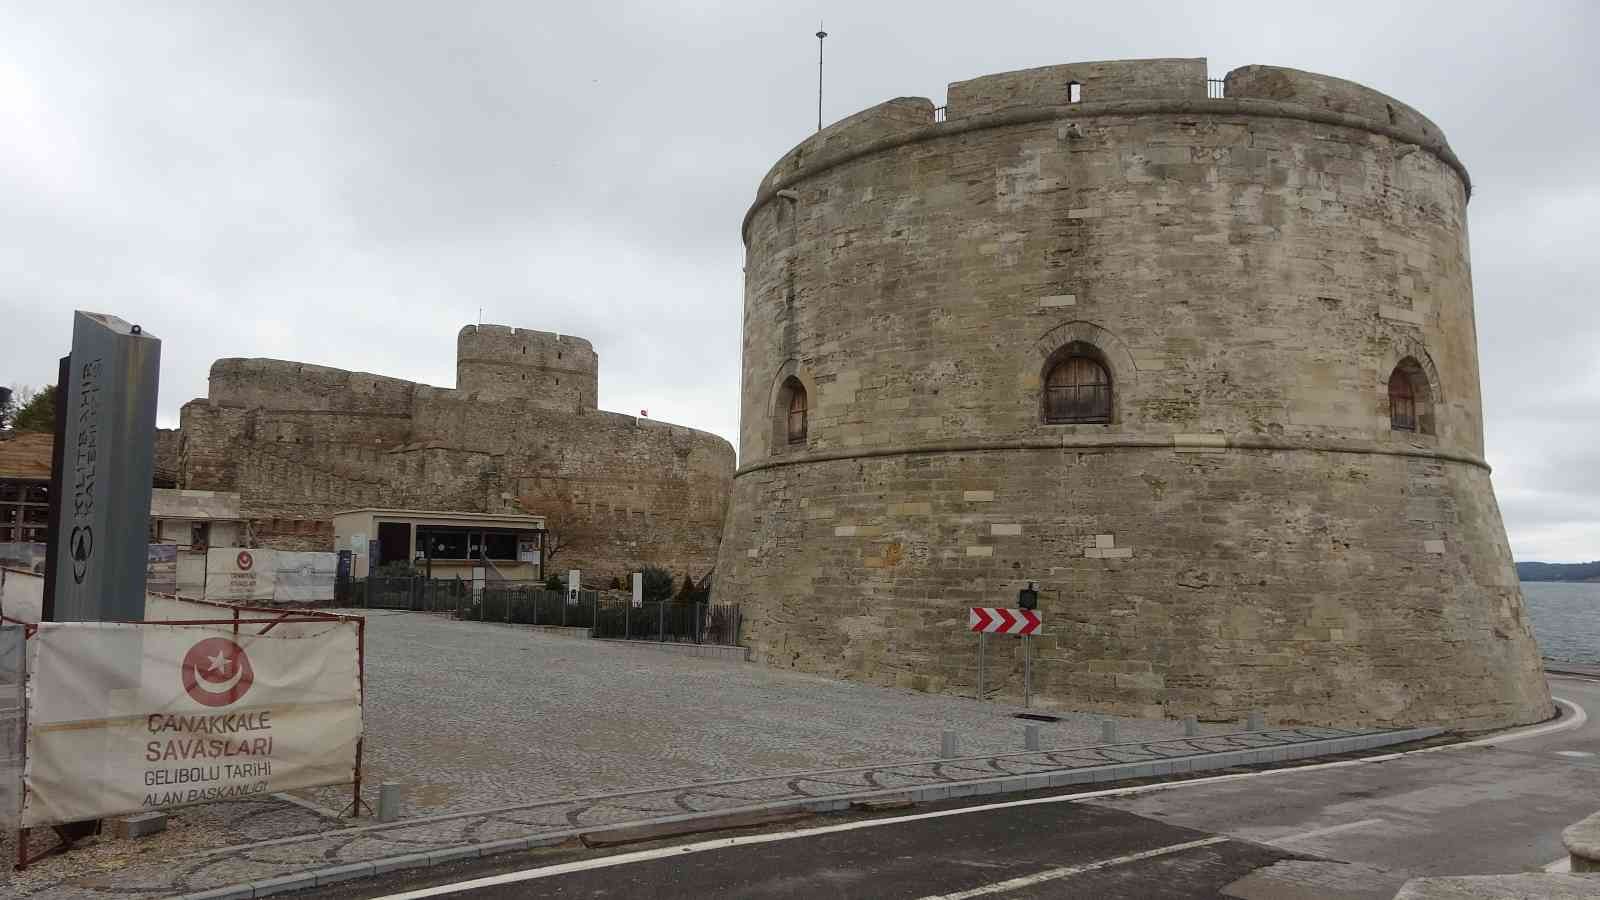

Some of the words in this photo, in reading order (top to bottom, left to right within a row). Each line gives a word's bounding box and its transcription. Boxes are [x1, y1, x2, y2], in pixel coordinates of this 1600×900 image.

[147, 711, 272, 735] ÇANAKKALE
[146, 736, 272, 761] SAVAŞLARI
[142, 791, 184, 807] ALAN
